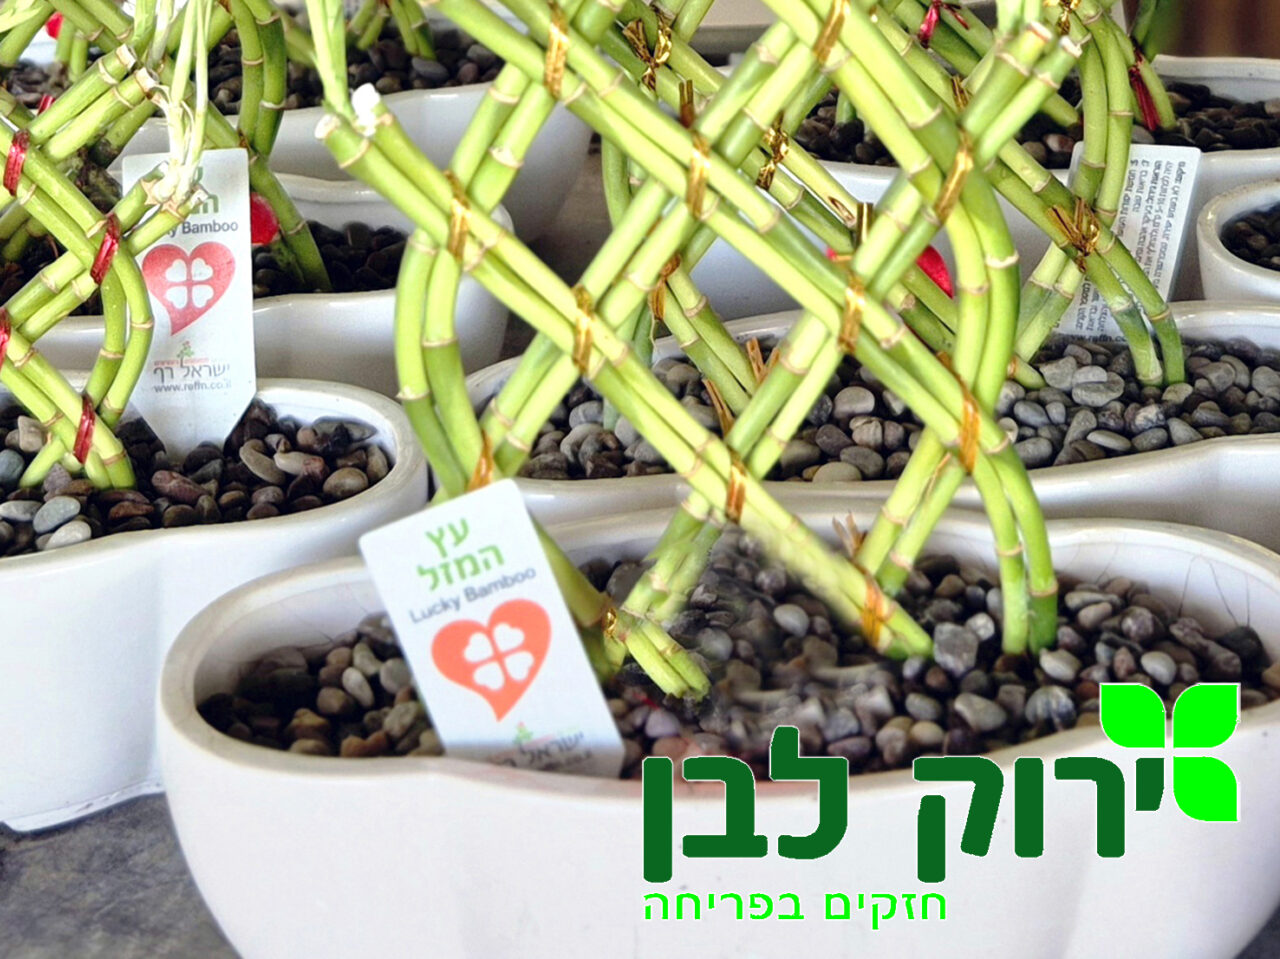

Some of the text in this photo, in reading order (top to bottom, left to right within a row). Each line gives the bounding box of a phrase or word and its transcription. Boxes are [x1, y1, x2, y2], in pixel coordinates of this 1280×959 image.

[182, 220, 239, 234] Bamboo
[153, 366, 174, 384] רף
[180, 355, 230, 378] ישראל
[425, 518, 470, 559] עץ
[416, 545, 505, 592] המזל
[409, 568, 537, 623] Lucky Bamboo
